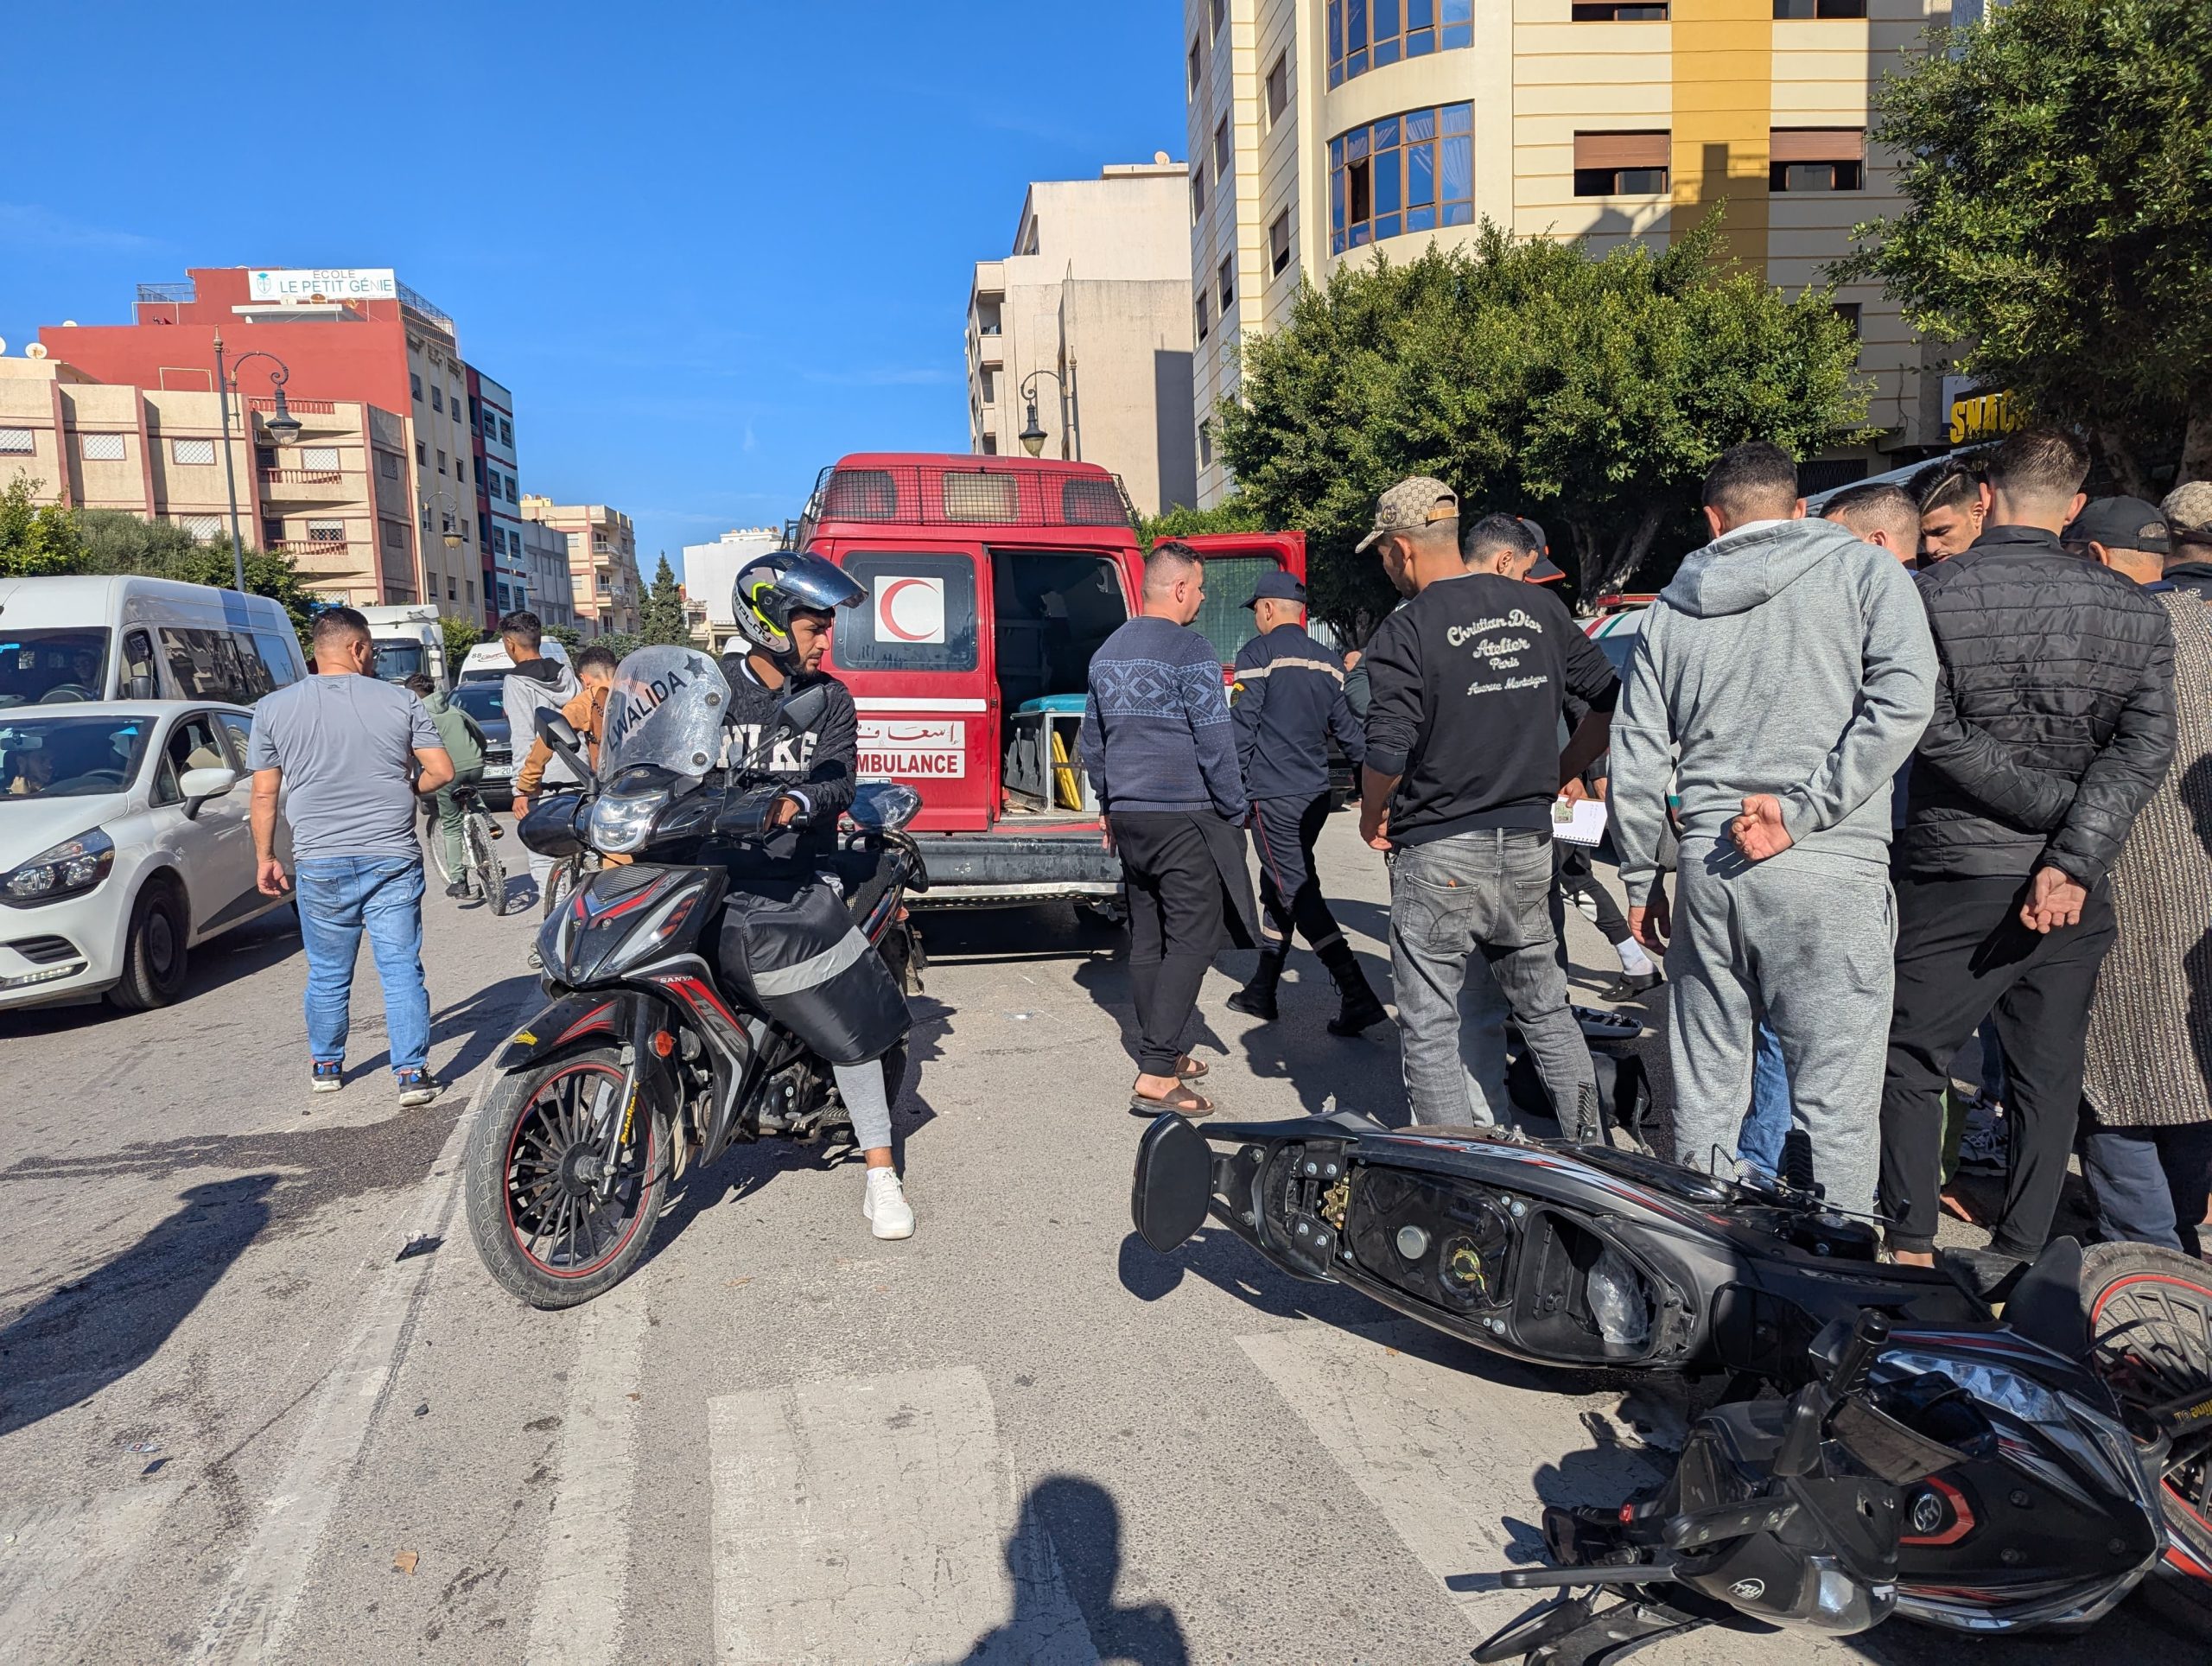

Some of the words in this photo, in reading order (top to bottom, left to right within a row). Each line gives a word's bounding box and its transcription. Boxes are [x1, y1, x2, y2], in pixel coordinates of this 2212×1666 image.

[313, 270, 356, 279] ECOLE
[280, 281, 297, 293] LE
[302, 281, 344, 292] PETIT
[349, 277, 392, 292] GÉNIE
[1446, 617, 1508, 646] Christian
[1507, 608, 1542, 633] Dior
[1472, 637, 1530, 658] Atelier
[1489, 657, 1519, 671] Paris
[856, 754, 958, 773] MBULANCE
